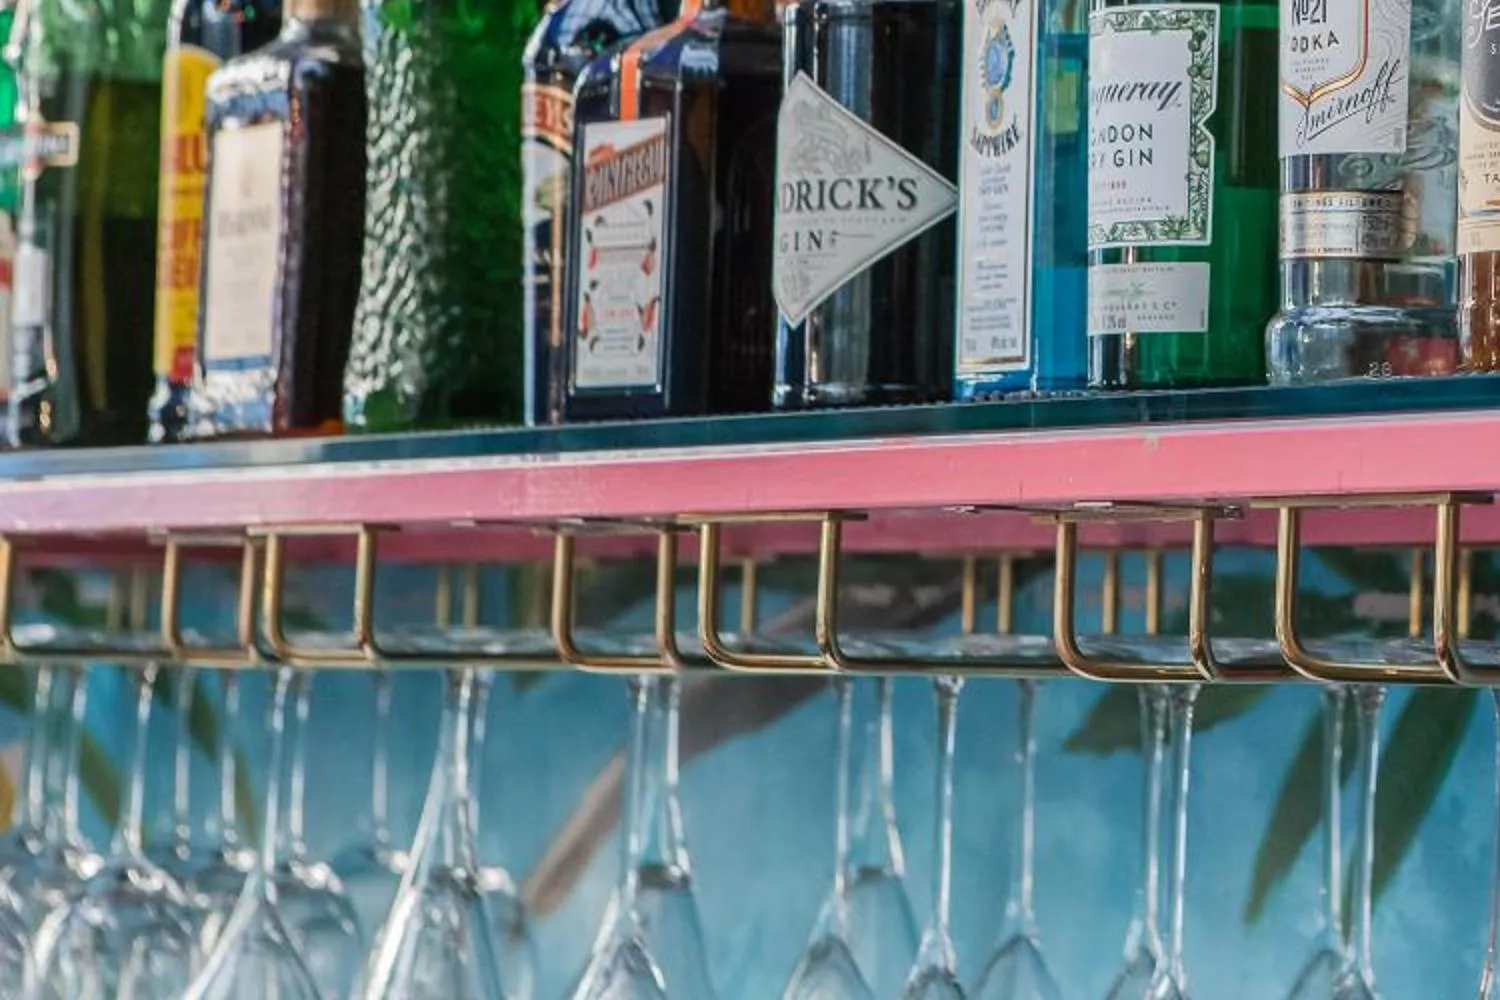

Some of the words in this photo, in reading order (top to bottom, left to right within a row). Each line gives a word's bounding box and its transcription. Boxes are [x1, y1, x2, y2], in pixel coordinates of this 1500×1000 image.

[1290, 30, 1340, 54] ODKA
[1112, 148, 1154, 169] GIN
[779, 230, 823, 254] GIN
